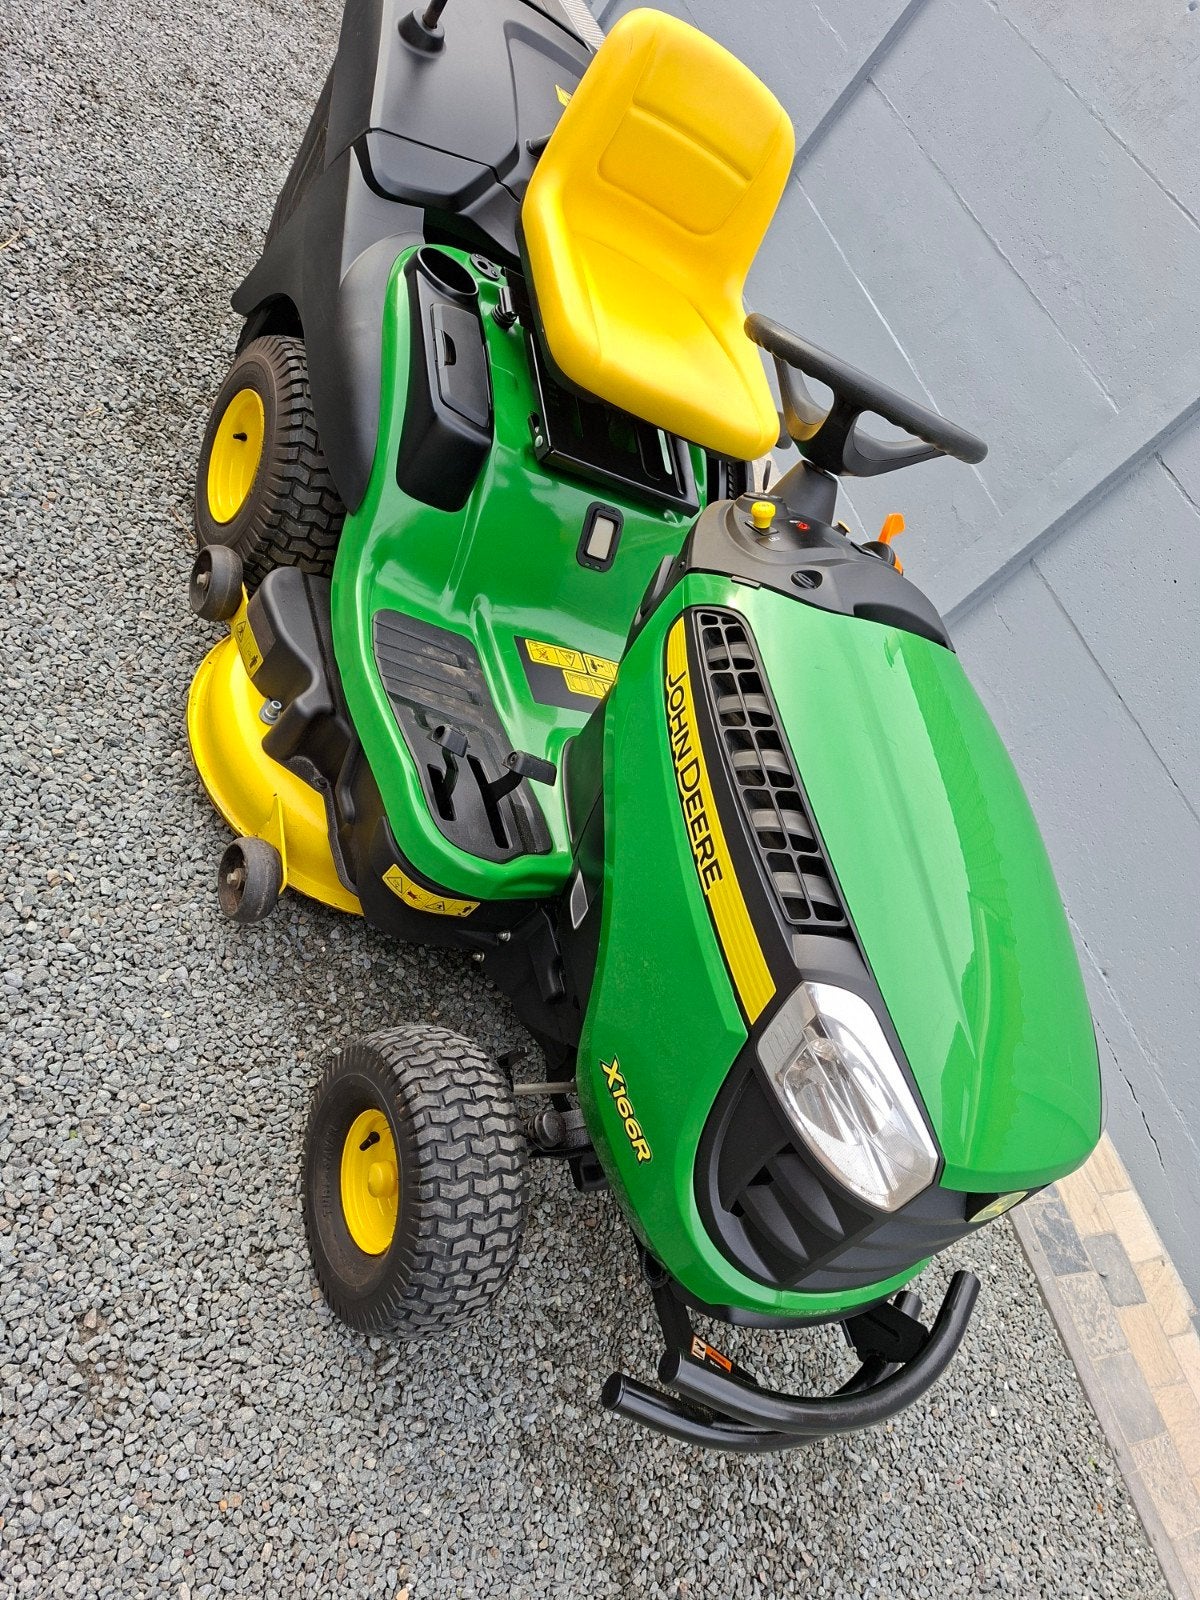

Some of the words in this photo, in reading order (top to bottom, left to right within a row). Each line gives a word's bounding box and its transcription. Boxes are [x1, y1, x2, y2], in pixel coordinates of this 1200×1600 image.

[668, 670, 692, 763] JOHN
[680, 757, 723, 891] DEERE
[600, 1057, 652, 1164] X166R
